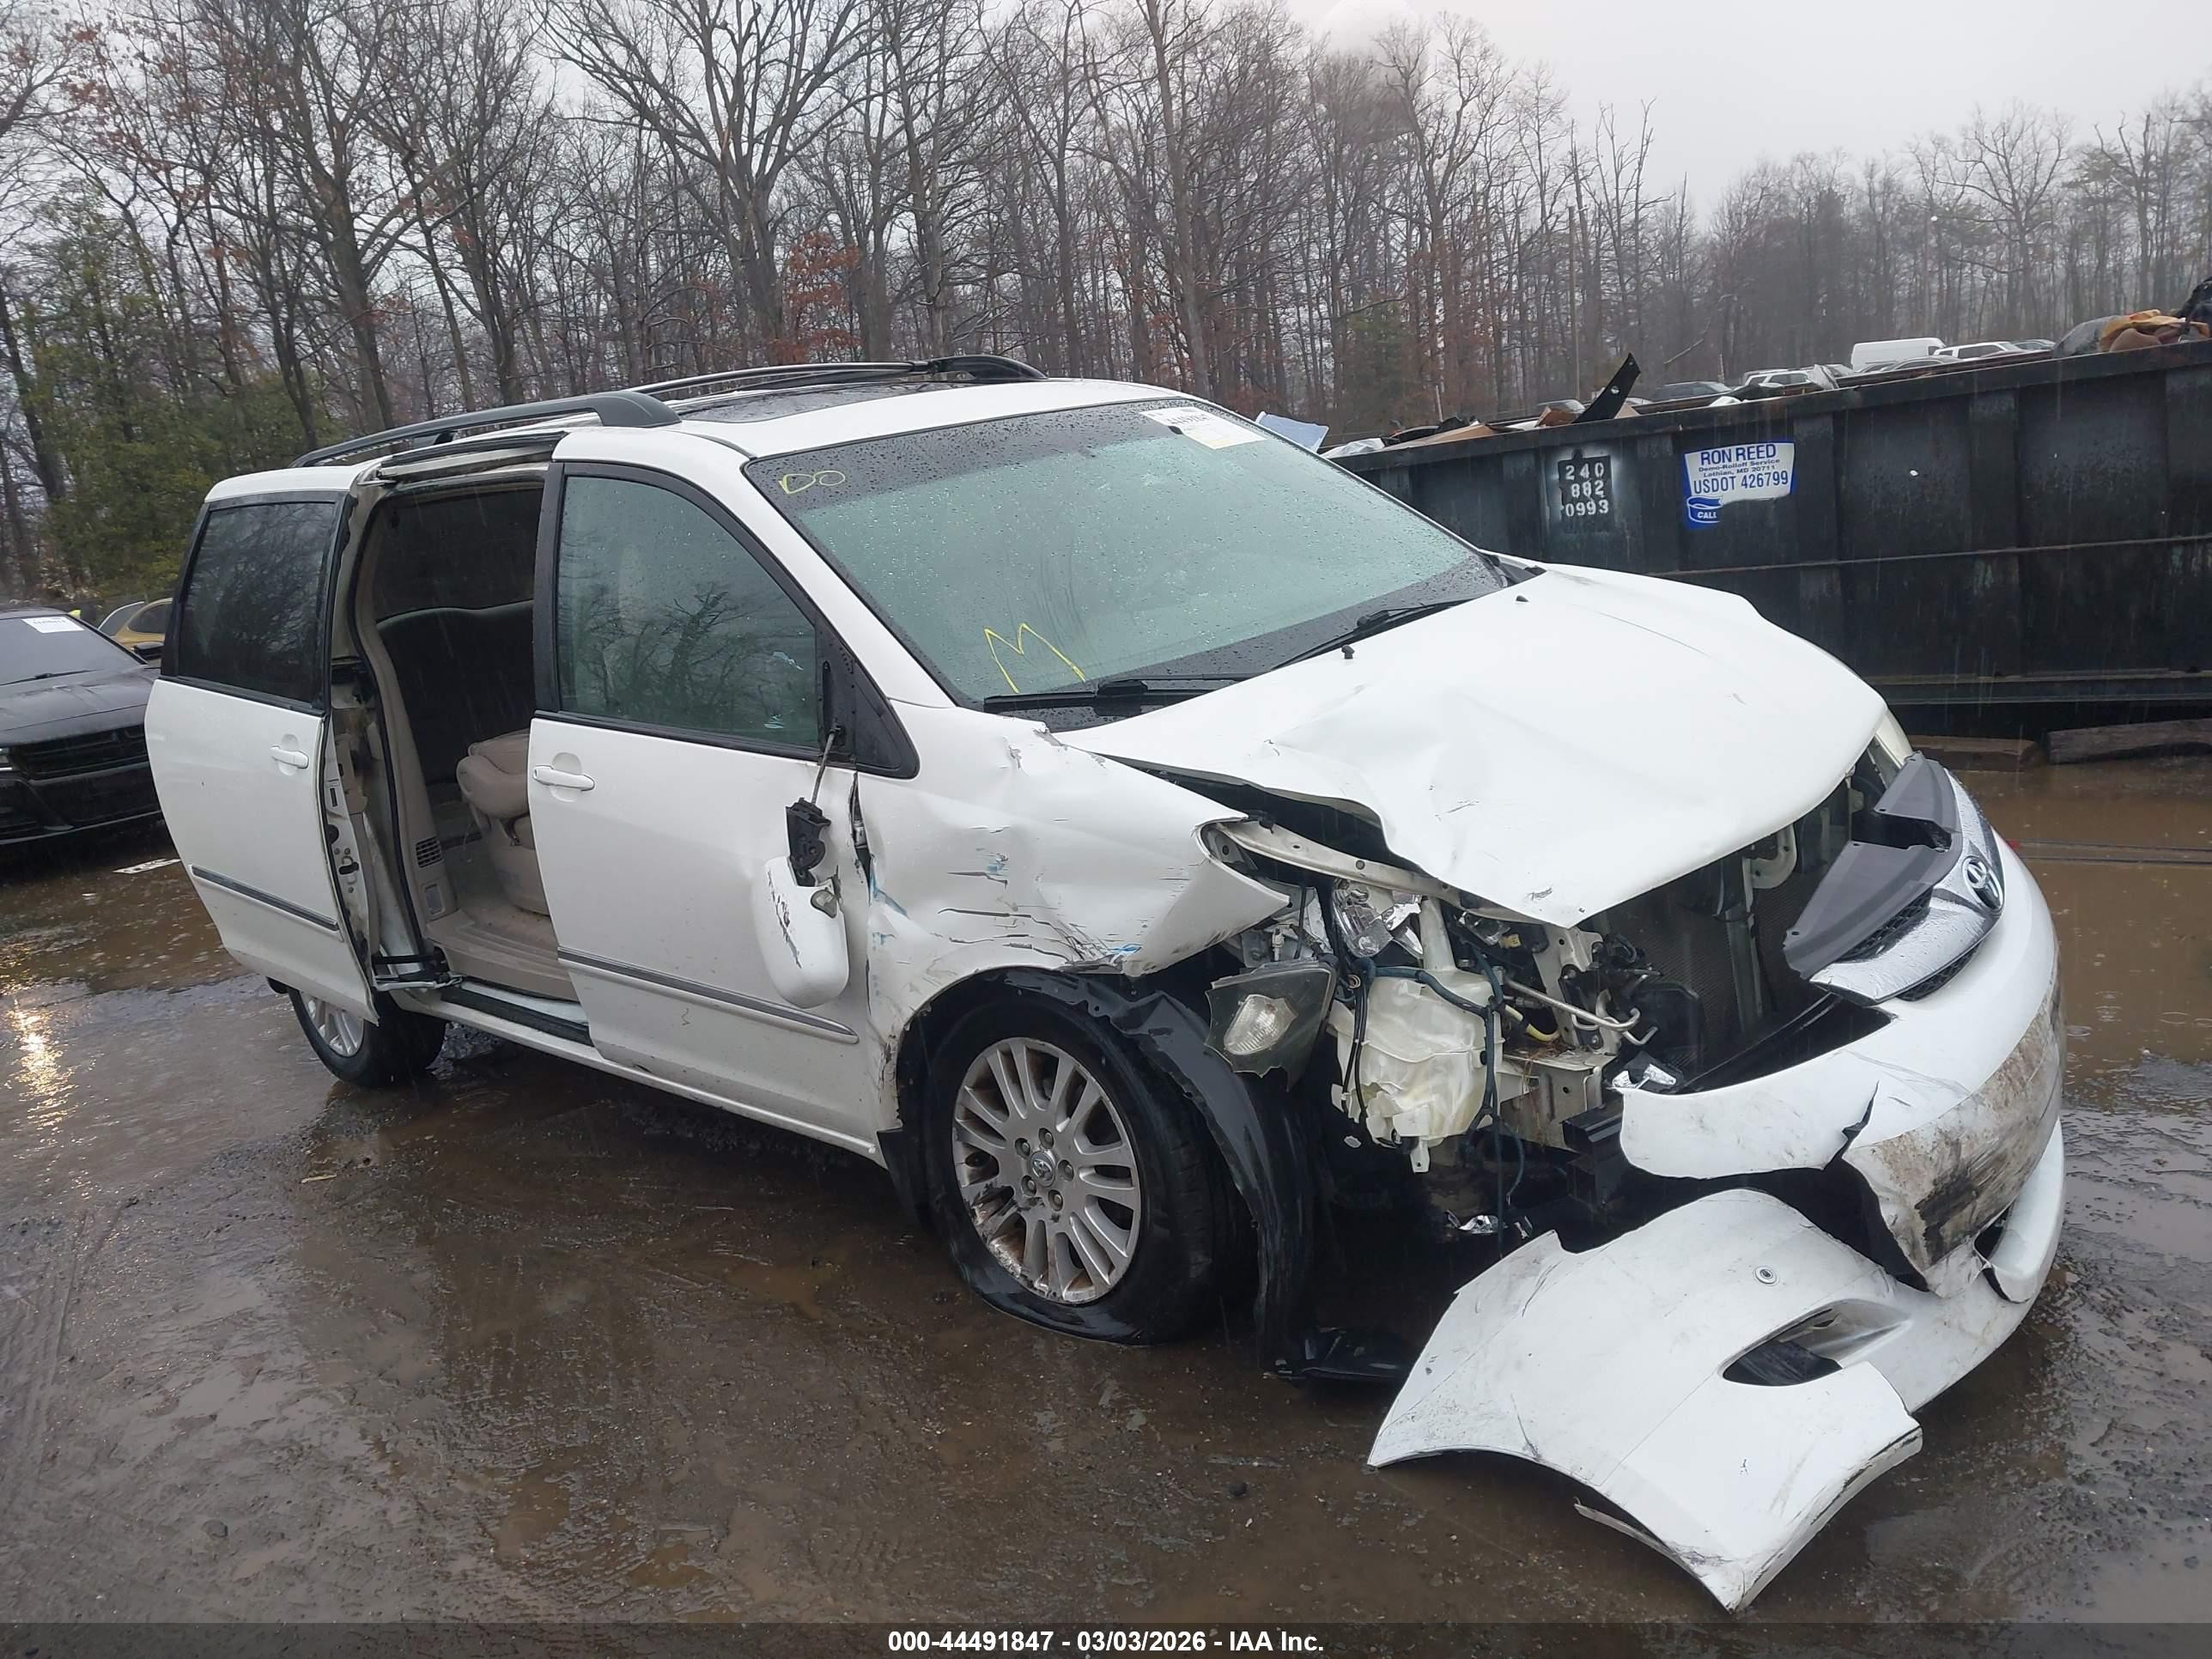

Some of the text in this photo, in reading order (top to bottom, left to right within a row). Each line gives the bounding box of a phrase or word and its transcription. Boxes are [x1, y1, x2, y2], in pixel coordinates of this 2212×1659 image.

[1700, 444, 1777, 465] RON REED
[1565, 462, 1605, 480] 240
[1693, 470, 1789, 495] USDOT 426799
[1565, 499, 1609, 517] 0993
[984, 623, 1086, 694] M
